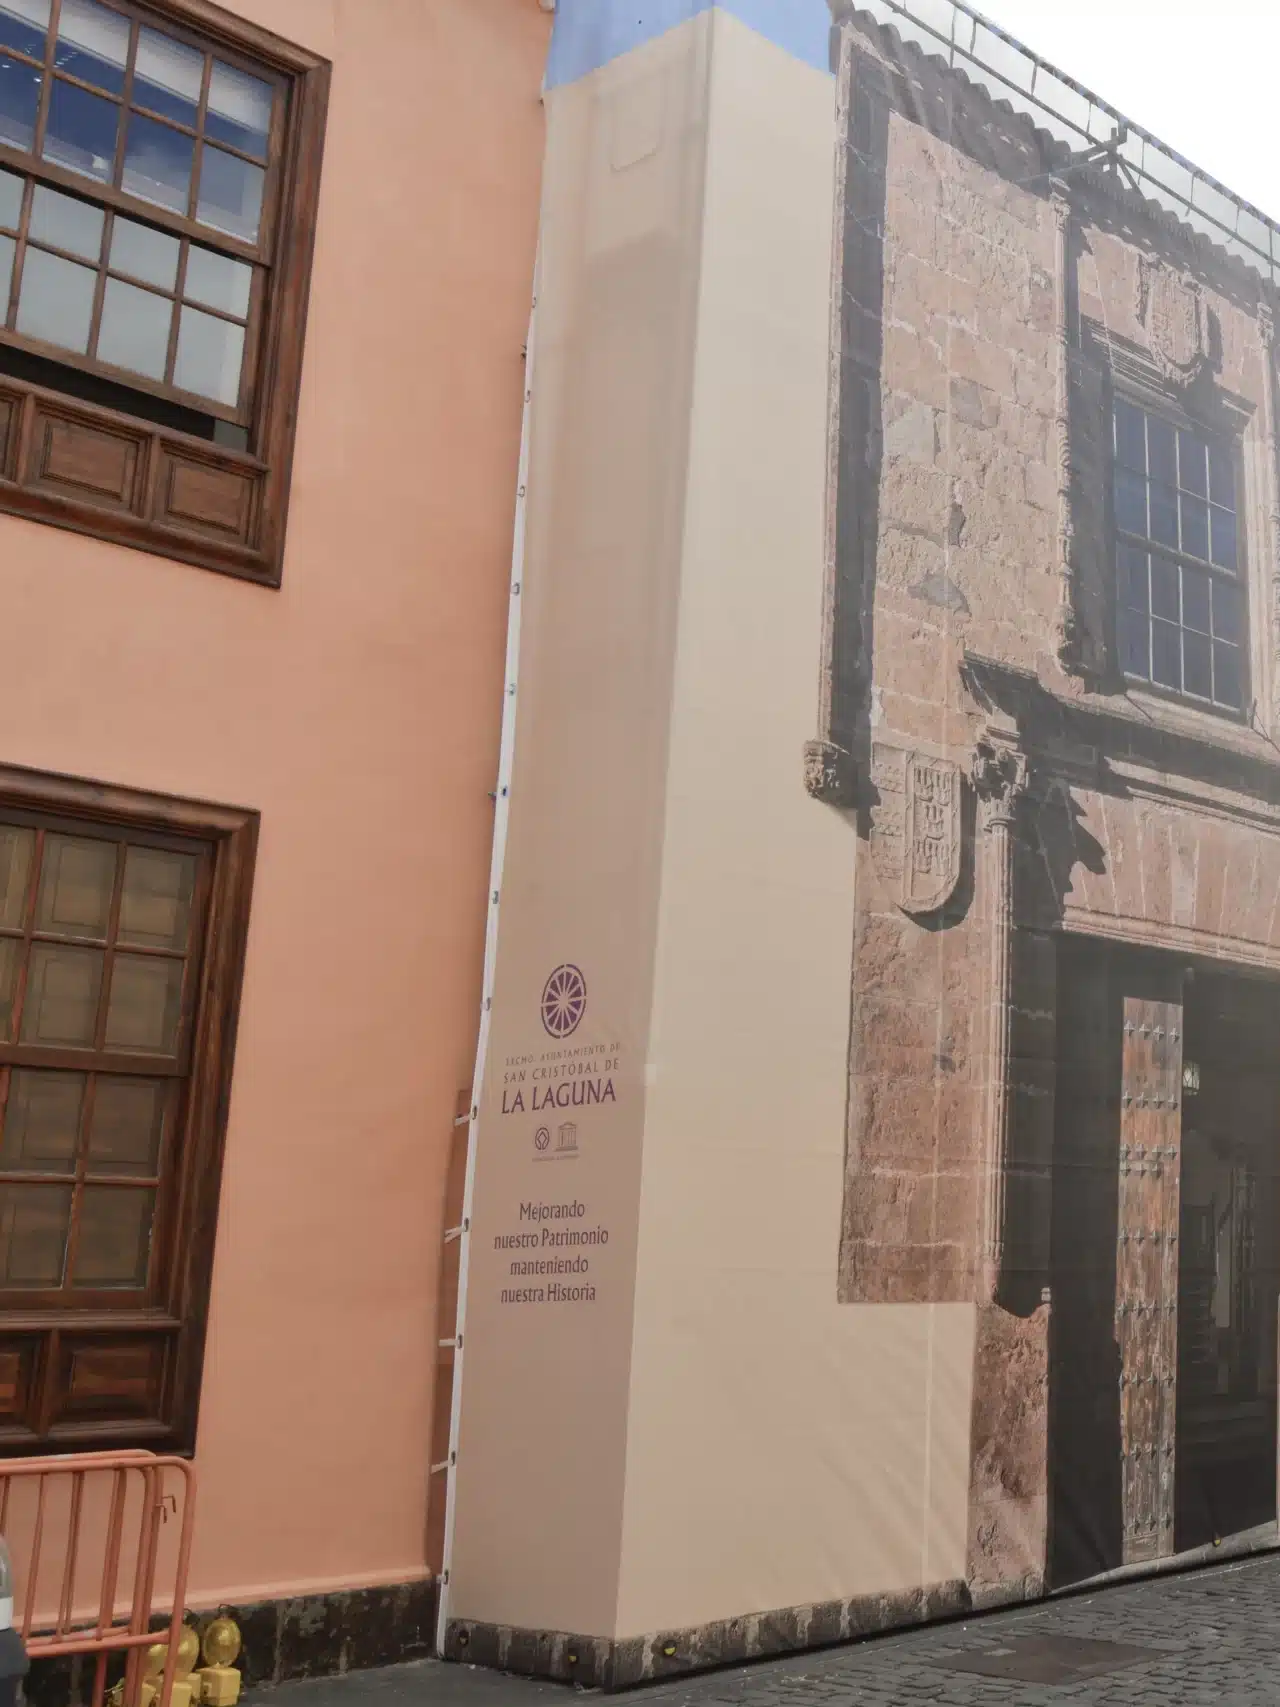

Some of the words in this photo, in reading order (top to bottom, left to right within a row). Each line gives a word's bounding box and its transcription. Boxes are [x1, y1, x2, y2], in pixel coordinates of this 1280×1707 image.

[504, 1070, 526, 1084] SAN
[532, 1061, 598, 1080] CRISTÓBAL
[605, 1058, 619, 1071] DE
[501, 1089, 525, 1114] LA
[532, 1078, 616, 1111] LAGUNA
[520, 1200, 585, 1223] Mejorando
[494, 1232, 539, 1249] nuestro
[541, 1225, 608, 1247] Patrimonio
[510, 1254, 589, 1275] manteniendo
[501, 1287, 544, 1303] nuestra
[547, 1282, 596, 1301] Historia
